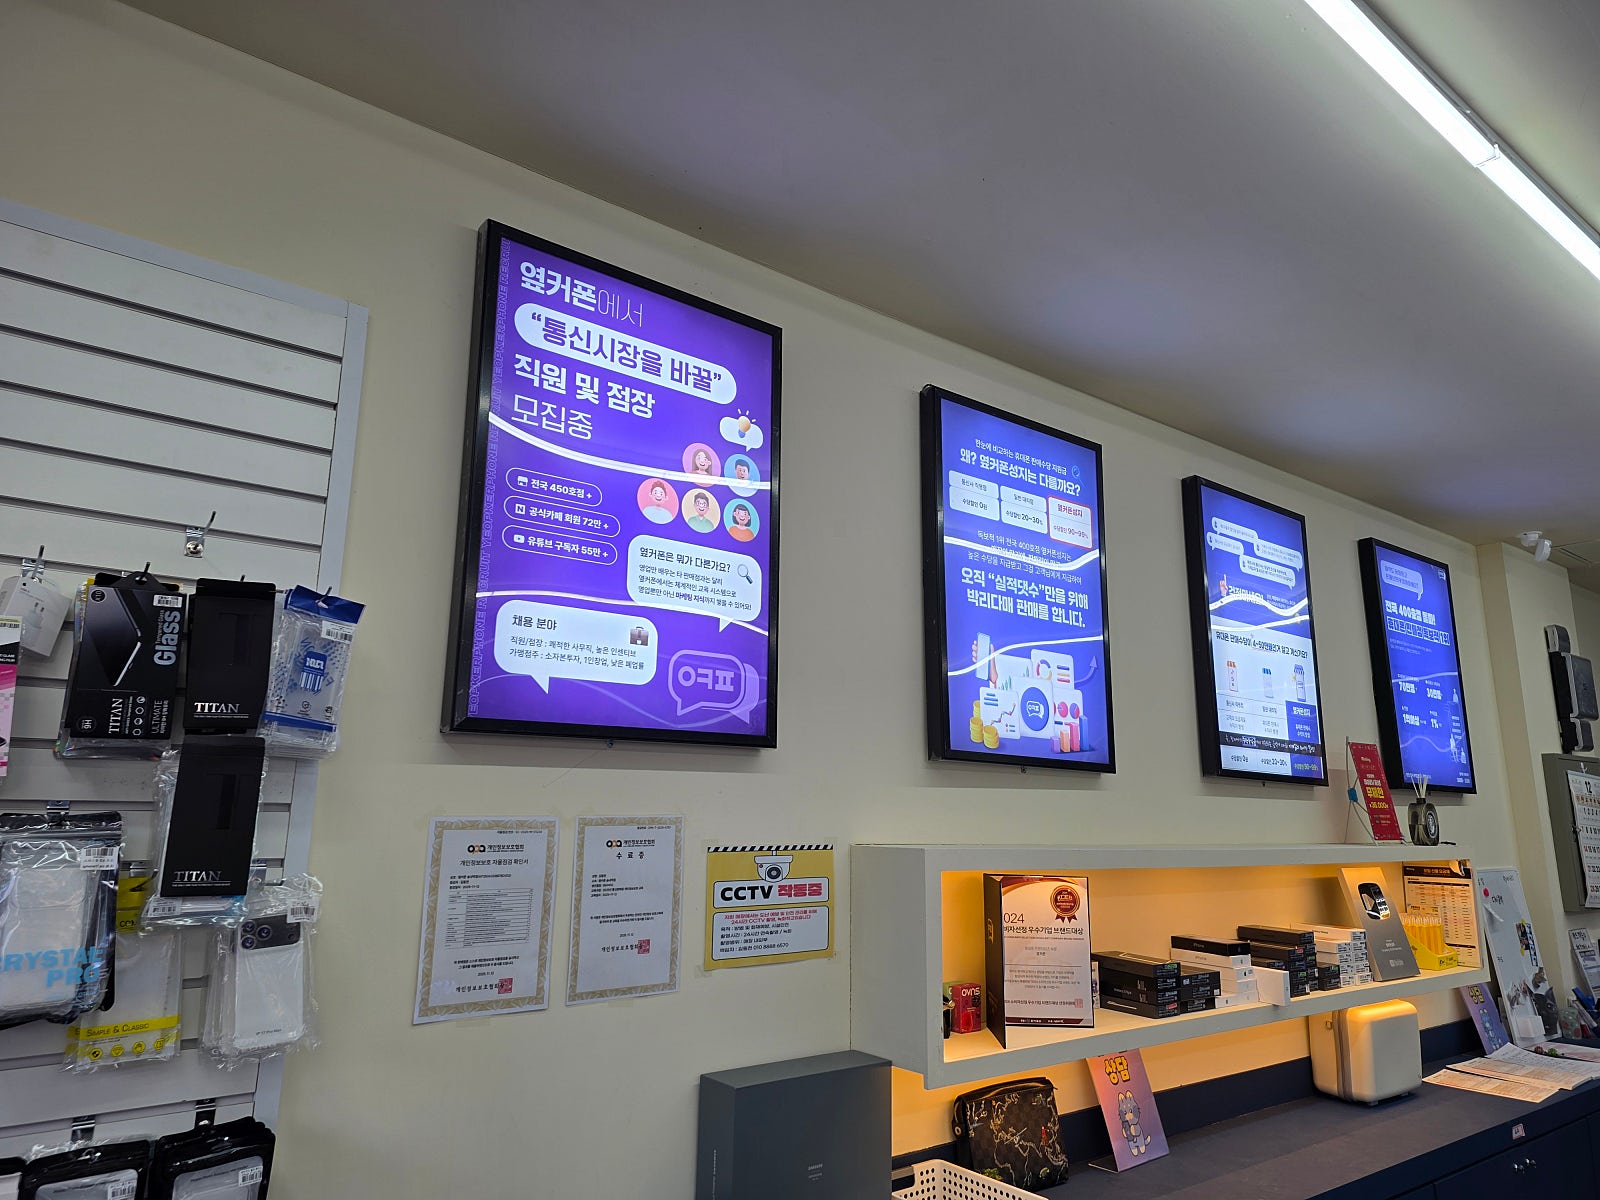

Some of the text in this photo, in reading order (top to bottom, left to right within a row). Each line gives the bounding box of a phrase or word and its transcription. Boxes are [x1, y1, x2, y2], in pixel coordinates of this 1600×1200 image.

[520, 262, 643, 327] 옆커폰에서
[514, 353, 655, 419] 직원 및 점장
[511, 395, 593, 440] 모집중
[993, 445, 1014, 459] 비교하는
[960, 448, 1081, 497] 왜? 옆커폰성지는 다를까요?
[531, 479, 548, 491] 전국
[550, 484, 585, 499] 450호점
[529, 506, 563, 522] 공식카페
[564, 513, 581, 525] 회원
[582, 517, 601, 529] 72만
[527, 536, 553, 549] 유튜브
[554, 541, 580, 554] 구독자
[581, 546, 601, 557] 55만
[640, 547, 731, 573] 옆커폰은 뭐가 다른가요?
[962, 567, 985, 587] 오직
[1068, 591, 1089, 610] 위해
[967, 588, 1086, 628] 박리다매 판매를 합니다.
[512, 614, 557, 631] 채용 분야
[154, 610, 180, 666] Glass
[511, 636, 544, 648] 직원/점장
[109, 698, 123, 734] TITAN
[194, 703, 240, 713] TITAN
[460, 859, 491, 867] 개인정보보호
[174, 871, 223, 882] TITAN
[721, 883, 822, 901] CCTV 작동중
[1028, 926, 1052, 934] 우수기업
[1053, 927, 1083, 935] 브랜드대상
[0, 946, 103, 971] RYSTAL
[46, 964, 100, 988] PRO
[113, 1024, 120, 1033] &
[1104, 1056, 1130, 1085] 상담
